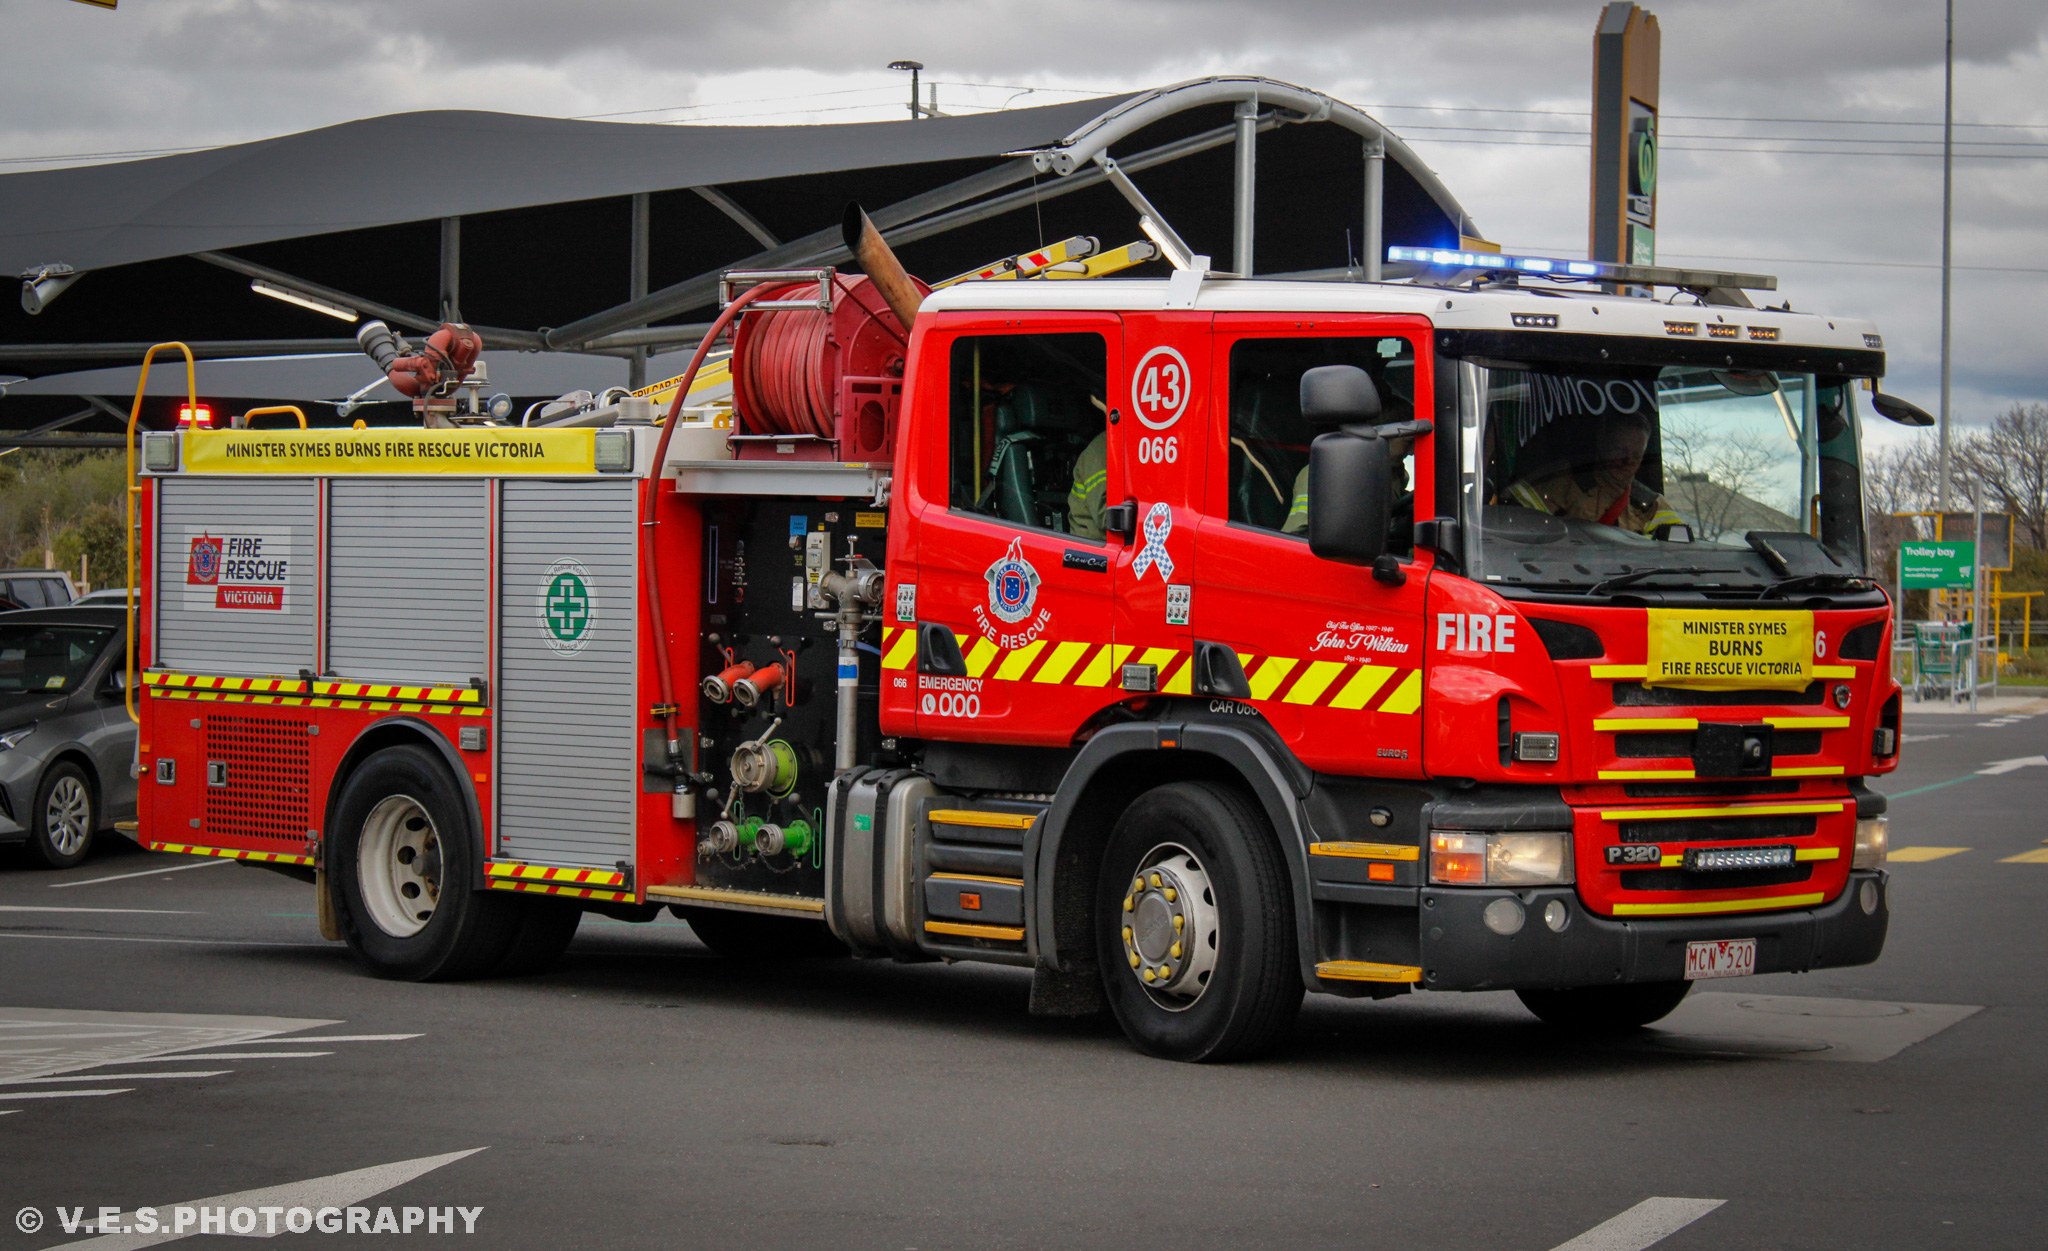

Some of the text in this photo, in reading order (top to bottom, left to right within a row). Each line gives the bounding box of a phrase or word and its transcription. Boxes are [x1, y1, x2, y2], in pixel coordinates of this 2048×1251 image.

[1140, 364, 1180, 411] 43
[226, 442, 545, 458] MINISTER SYMES BURNS FIRE RESCUE VICTORIA
[1138, 436, 1178, 464] 066
[228, 537, 263, 557] FIRE
[1905, 546, 1955, 558] Trolley bay
[225, 559, 287, 581] RESCUE
[553, 564, 572, 573] Rescue
[997, 564, 1028, 582] FIRE RESCUE
[223, 590, 275, 605] VICTORIA
[1000, 600, 1024, 612] VICTORIA
[972, 604, 1051, 649] FIRE RESCUE
[1436, 613, 1516, 653] FIRE
[1683, 622, 1787, 635] MINISTER SYMES
[1309, 631, 1410, 653] John T Wilkins
[1709, 640, 1763, 656] BURNS
[1815, 630, 1827, 658] 6
[1662, 662, 1802, 675] FIRE RESCUE VICTORIA
[893, 677, 907, 688] 066
[919, 675, 984, 692] EMERGENCY
[939, 692, 980, 719] 000
[1209, 699, 1234, 714] CAR
[1608, 846, 1661, 863] P 320
[1688, 945, 1752, 971] MCN 520
